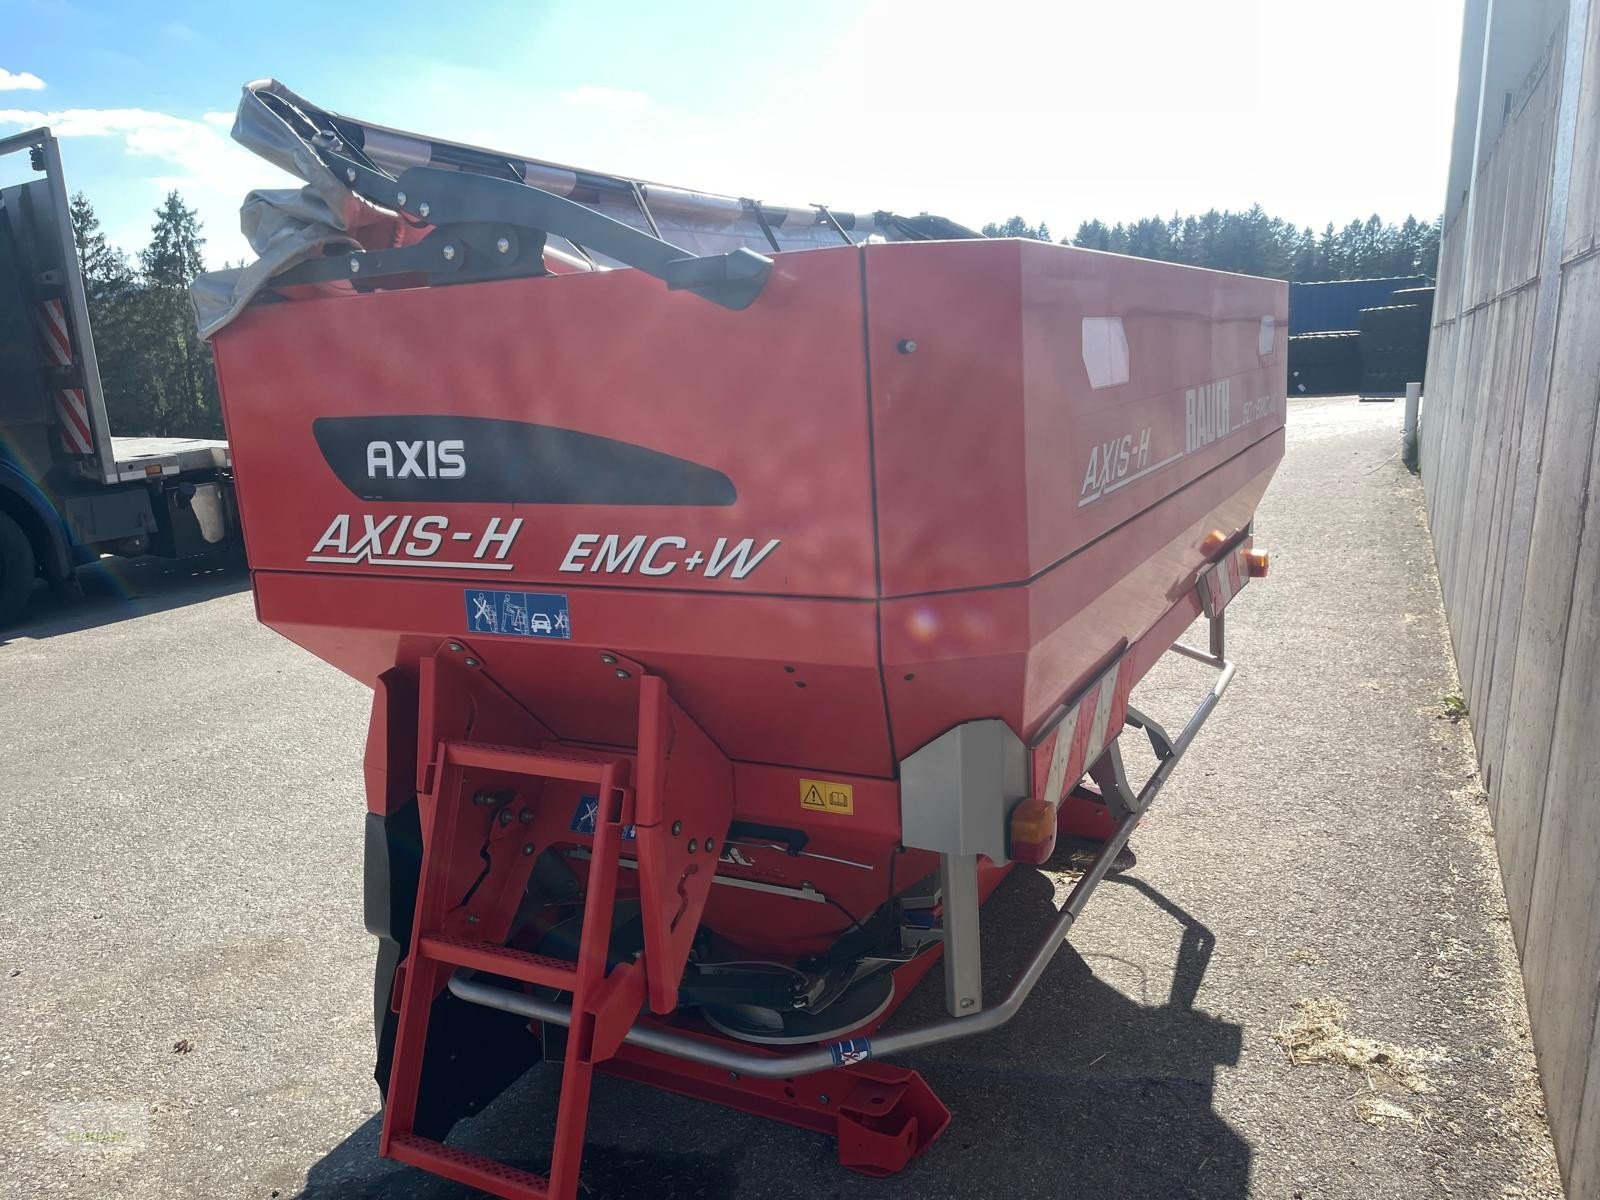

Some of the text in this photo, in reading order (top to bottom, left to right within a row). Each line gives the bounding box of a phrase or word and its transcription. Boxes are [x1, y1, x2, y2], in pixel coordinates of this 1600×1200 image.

[1185, 379, 1230, 454] RAUCH
[366, 439, 467, 479] AXIS
[1081, 427, 1152, 495] AXIS-H
[311, 513, 781, 580] AXIS-H EMC+W
